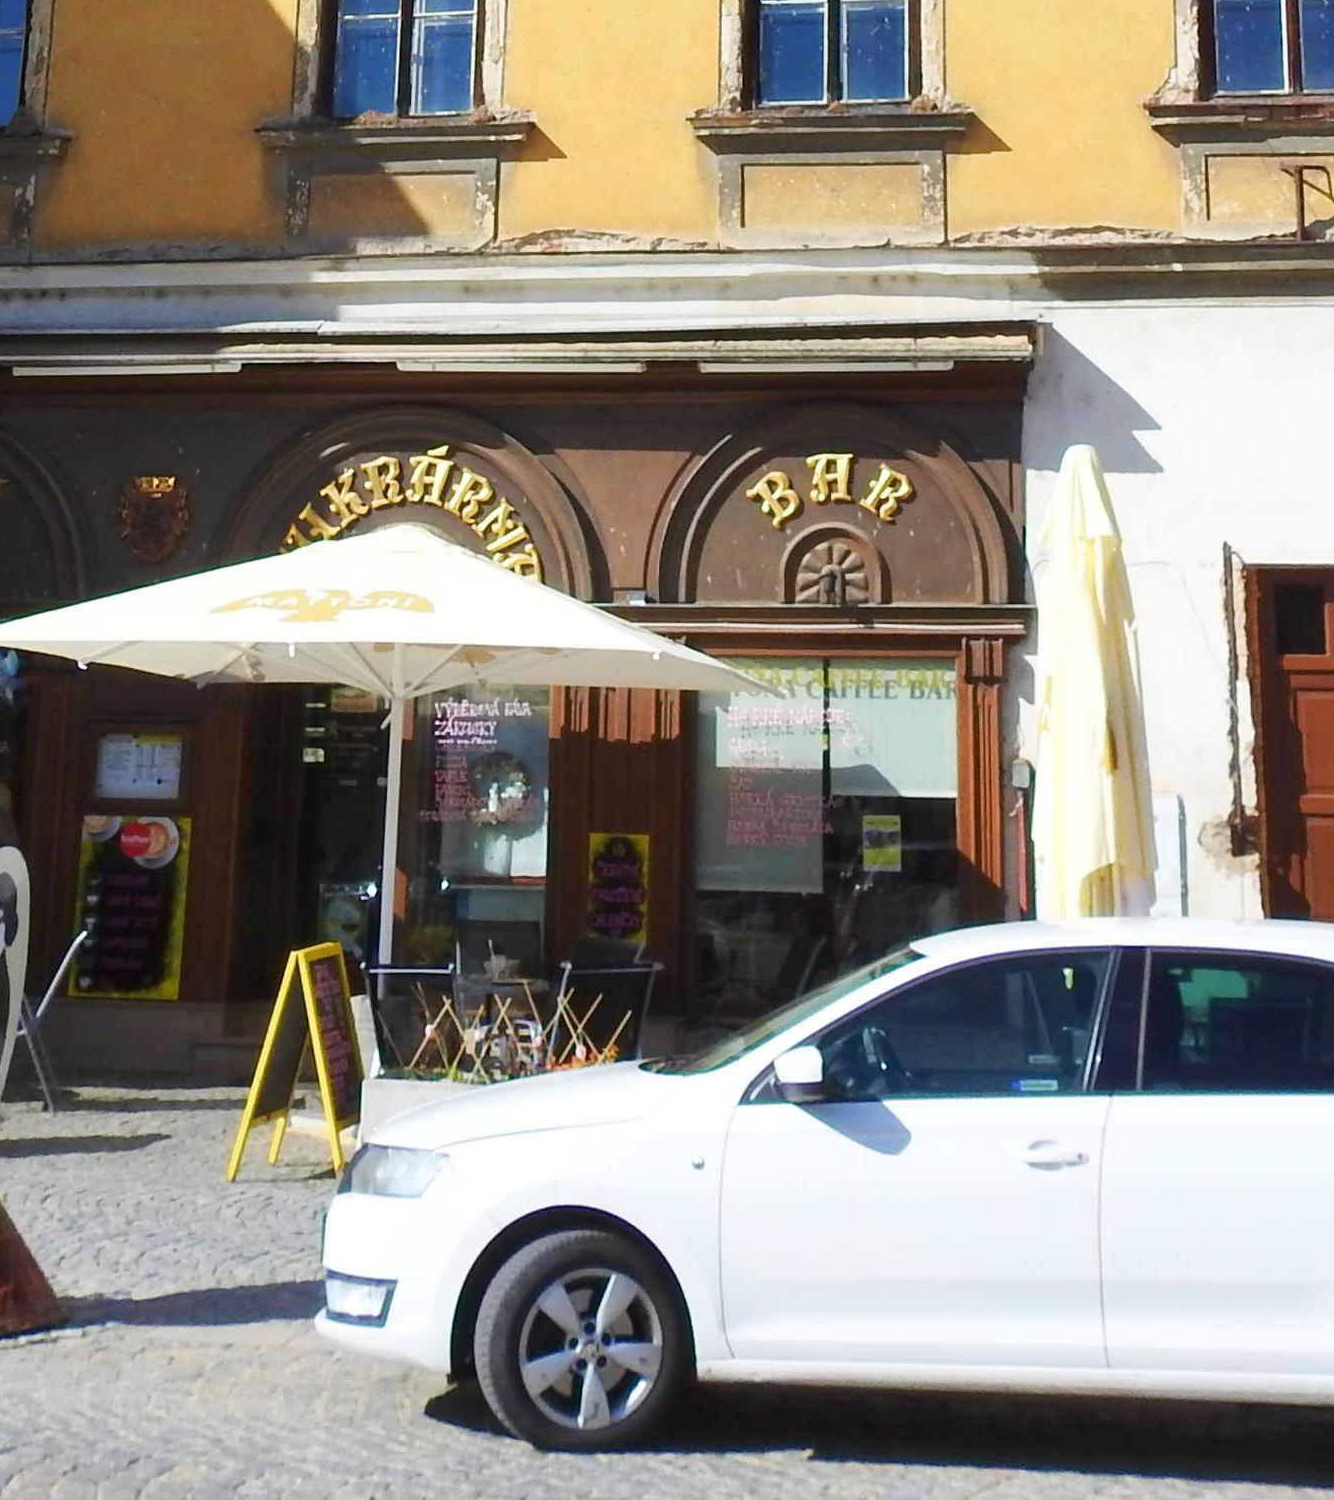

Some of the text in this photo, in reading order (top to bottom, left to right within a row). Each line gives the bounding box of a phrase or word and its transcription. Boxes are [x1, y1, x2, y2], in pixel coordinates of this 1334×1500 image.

[279, 445, 544, 584] UKRÁRNA
[746, 453, 914, 530] BAR
[246, 594, 416, 611] MATTONI
